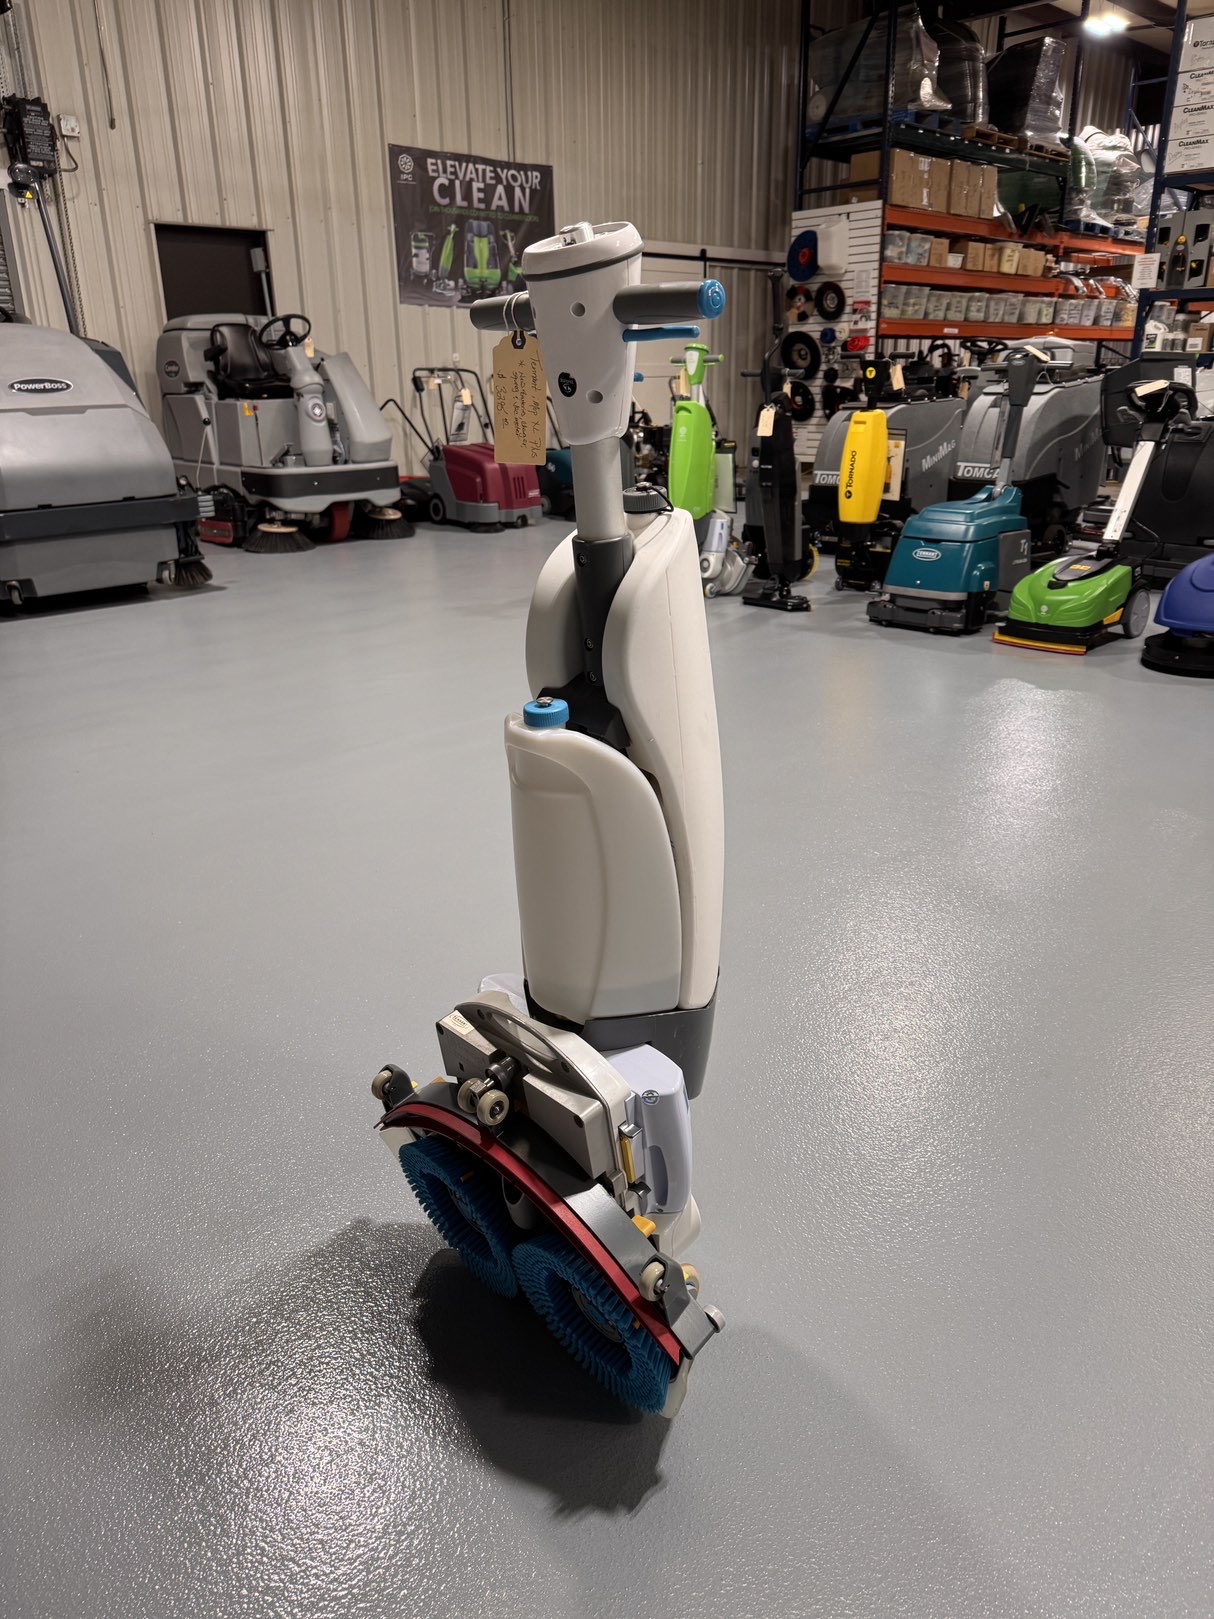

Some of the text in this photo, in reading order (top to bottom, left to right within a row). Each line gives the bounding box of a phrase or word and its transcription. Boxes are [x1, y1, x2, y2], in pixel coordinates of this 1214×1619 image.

[426, 158, 541, 190] ELEVATE YOUR
[432, 177, 531, 214] CLEAN
